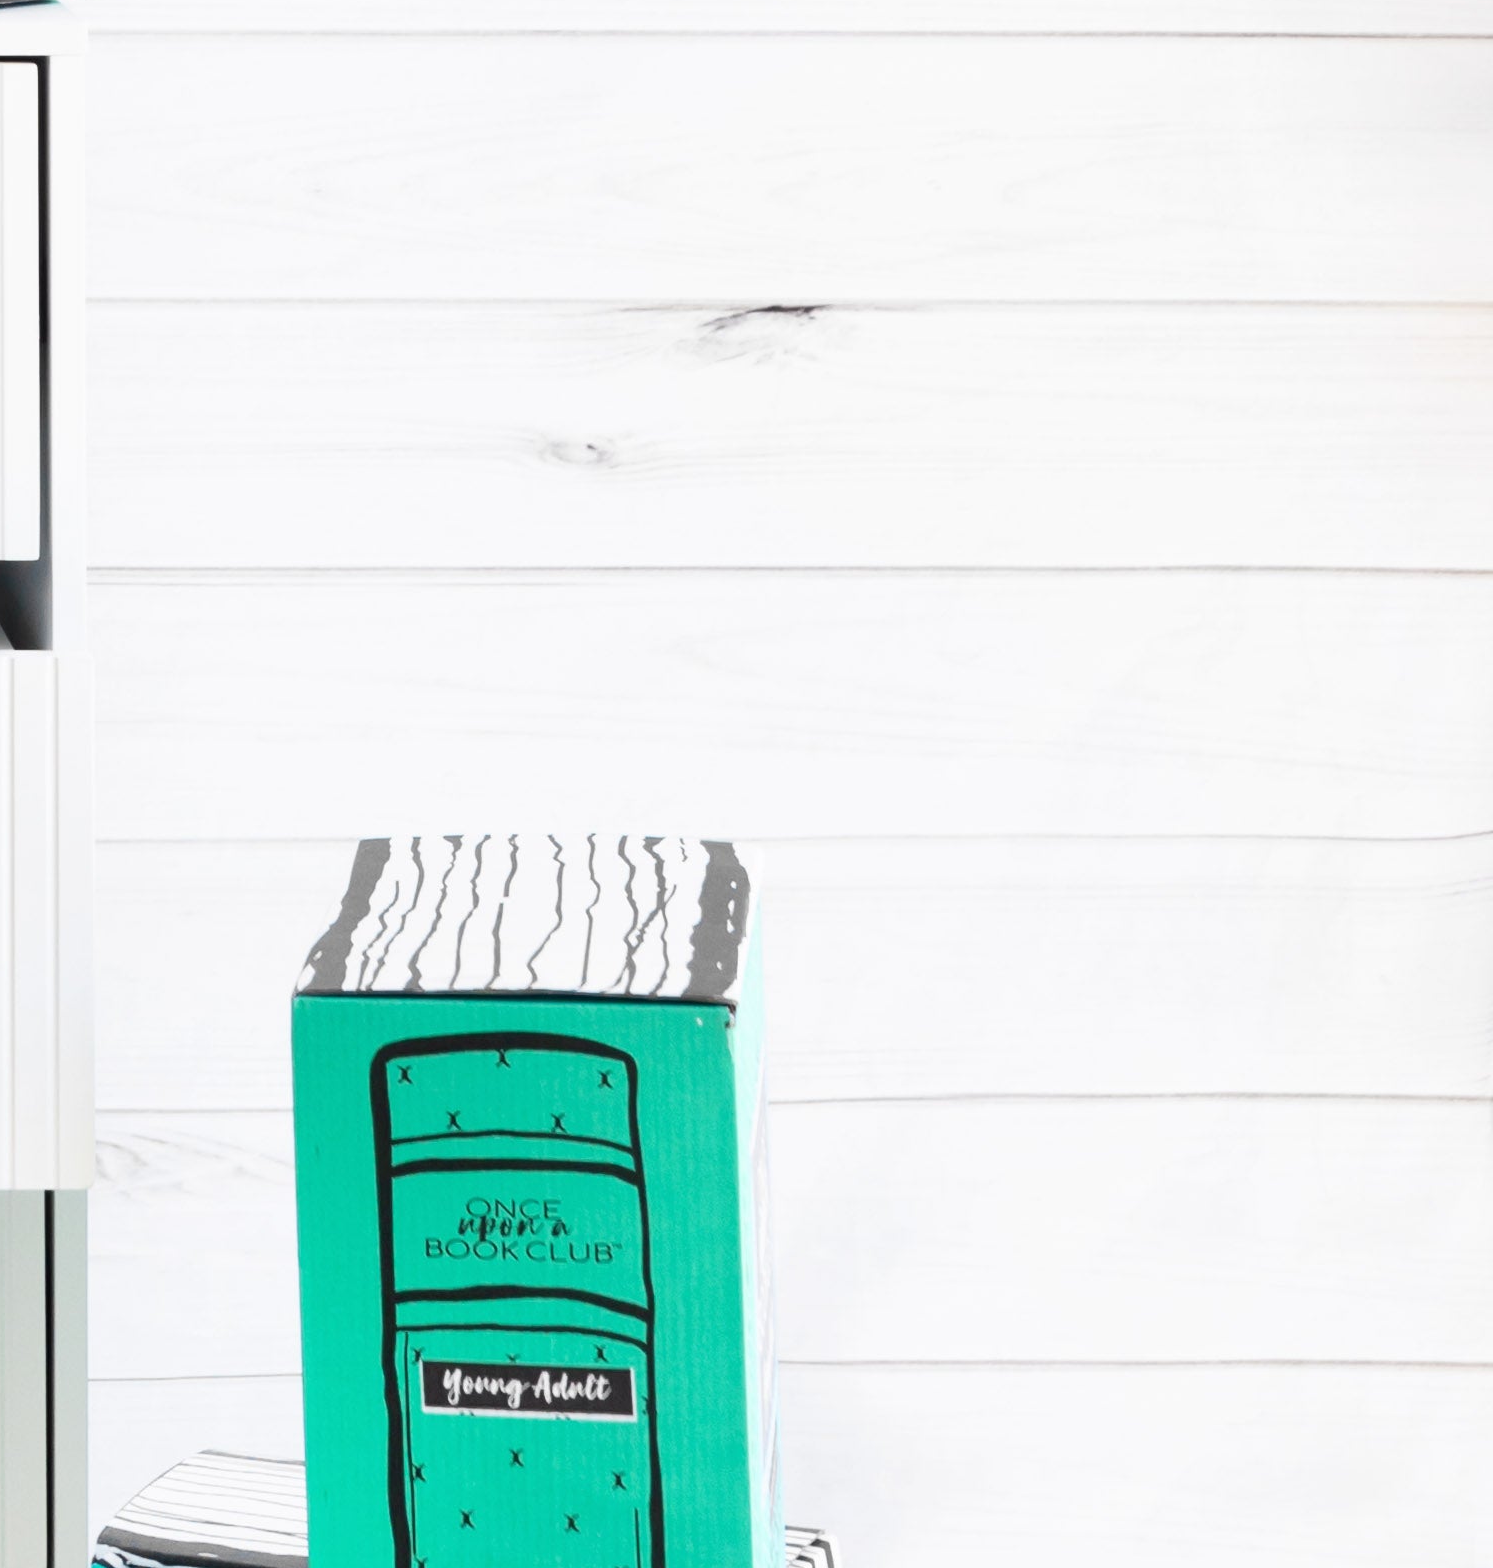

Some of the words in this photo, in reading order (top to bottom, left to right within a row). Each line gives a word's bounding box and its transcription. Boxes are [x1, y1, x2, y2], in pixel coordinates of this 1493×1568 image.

[466, 1197, 562, 1220] ONCE
[458, 1215, 545, 1241] upon
[425, 1237, 520, 1262] BOOK
[443, 1368, 530, 1409] Young
[532, 1370, 612, 1405] Adult
